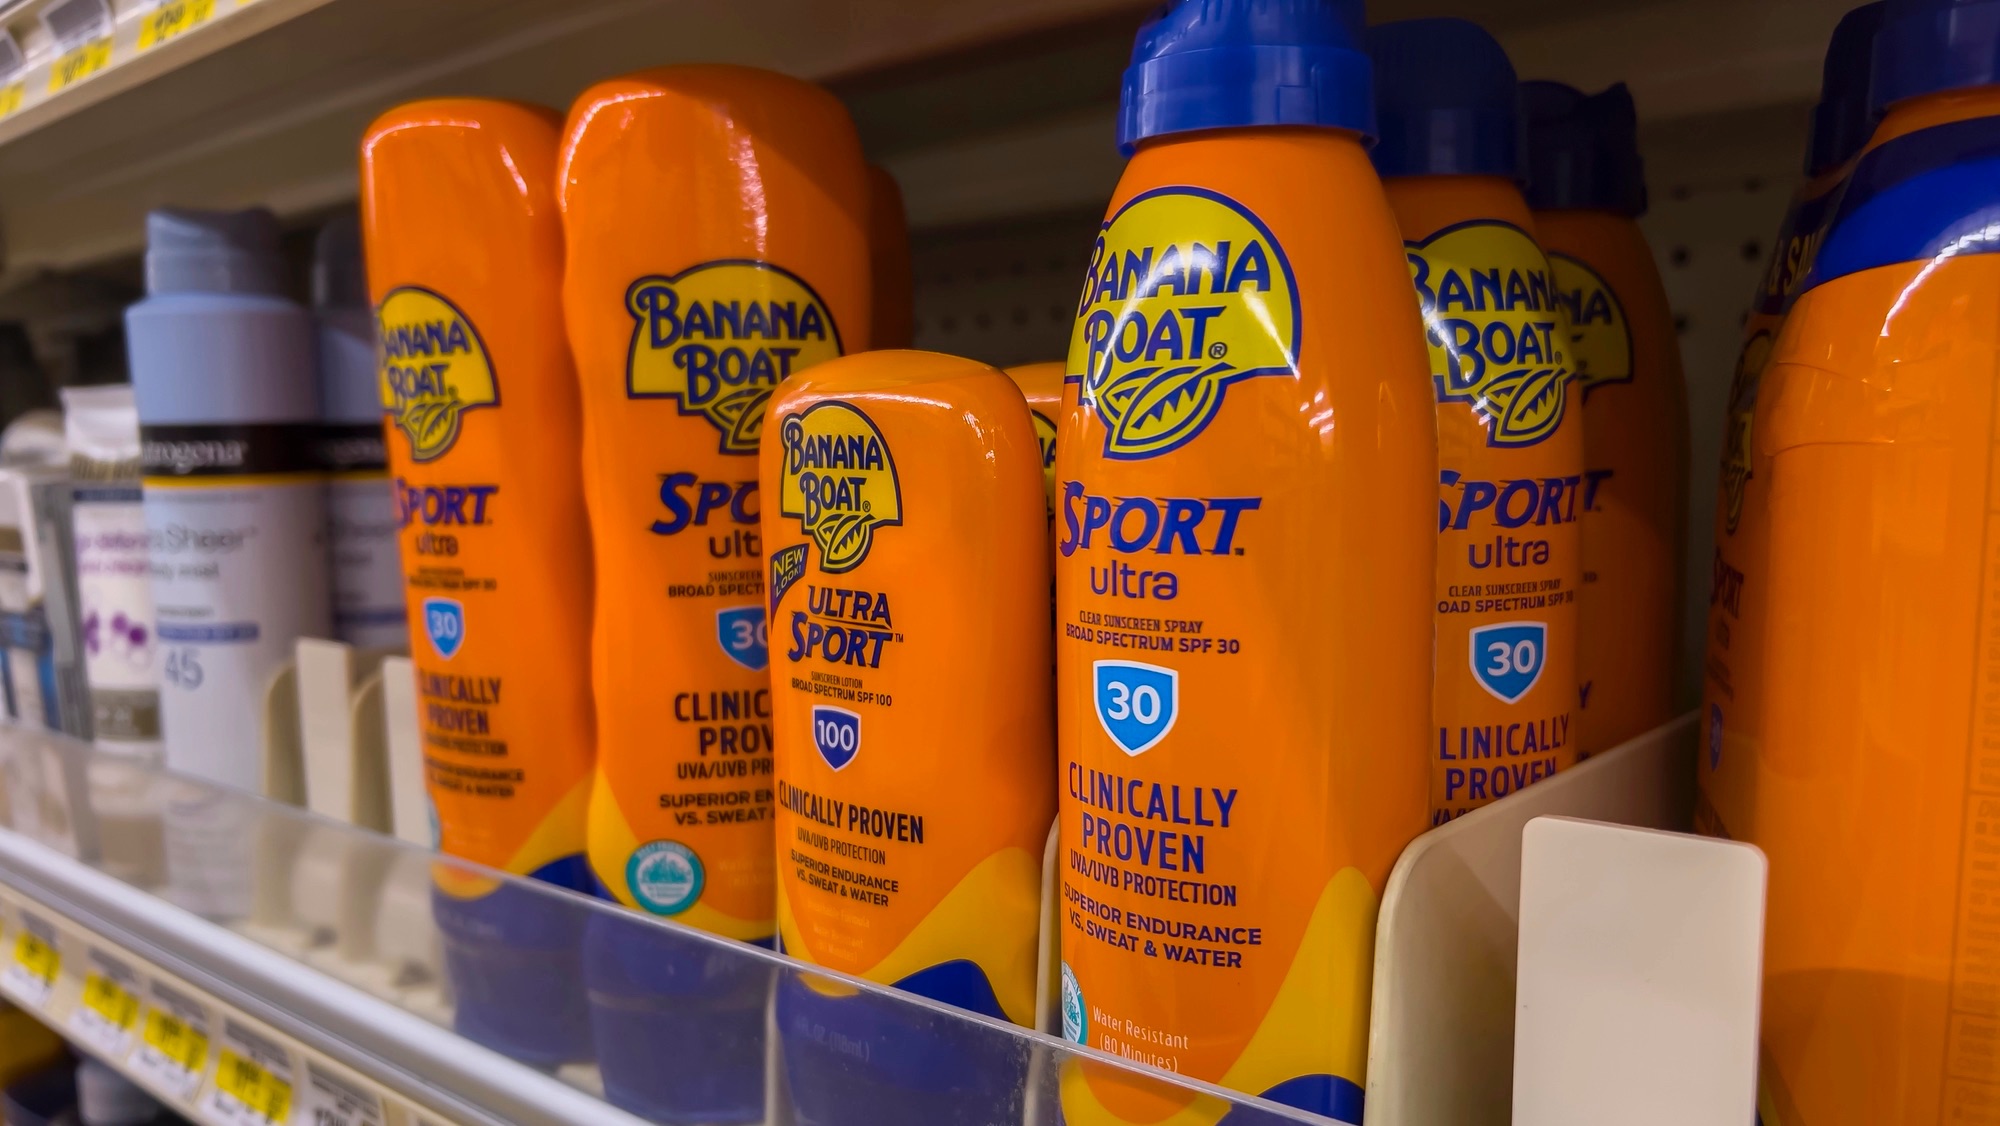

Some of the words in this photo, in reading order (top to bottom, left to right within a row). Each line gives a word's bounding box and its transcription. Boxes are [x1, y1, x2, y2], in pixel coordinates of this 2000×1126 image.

[1079, 239, 1271, 318] BANANA
[636, 285, 827, 350] BANANA
[380, 318, 472, 358] ANANA
[672, 344, 802, 404] BOAT
[785, 421, 884, 476] BANANA
[648, 472, 760, 536] SPO
[1059, 480, 1262, 557] SPORT
[708, 529, 762, 559] ult
[1468, 535, 1550, 570] ultra
[772, 547, 805, 584] NEW
[1090, 560, 1178, 600] ultra
[668, 584, 715, 598] BROAD
[718, 583, 765, 597] SPECT
[808, 585, 893, 630] ULTRA
[1437, 600, 1471, 614] OAD
[1474, 596, 1546, 613] SPECTRUM
[1547, 591, 1565, 607] SPF
[1448, 585, 1482, 598] CLEAR
[1485, 581, 1538, 596] SUNSCREEN
[1539, 578, 1562, 593] SPRAY
[430, 609, 457, 640] 30
[1066, 623, 1094, 643] BROAD
[1096, 630, 1173, 652] SPECTRUM
[1178, 638, 1212, 654] SPF
[1217, 639, 1240, 654] 30
[1079, 610, 1101, 626] CLEAR
[1104, 614, 1160, 632] SUNSCREEN
[1165, 620, 1203, 633] SPRAY
[164, 647, 205, 691] 45
[1487, 639, 1536, 677] 30
[791, 677, 813, 694] BROAD
[814, 682, 855, 701] SPECTRUM
[857, 691, 874, 704] SPF
[875, 692, 892, 707] 100
[811, 670, 841, 686] SUNSCREEN
[841, 676, 863, 689] LOTION
[674, 688, 773, 722] CLINIC
[1107, 680, 1161, 725] 30
[699, 723, 774, 757] PROV
[817, 719, 855, 751] 100
[1440, 712, 1569, 761] LINICALLY
[677, 760, 748, 780] UVA/UVB
[1446, 757, 1557, 801] PROVEN
[659, 790, 750, 809] SUPERIOR
[779, 779, 844, 830] CLINICALLY
[848, 803, 925, 845] PROVEN
[1069, 761, 1238, 828] CLINICALLY
[674, 811, 703, 827] VS.
[706, 807, 767, 825] SWEAT
[797, 826, 829, 852] UVA/UVB
[830, 834, 886, 866] PROTECTION
[1082, 811, 1204, 875] PROVEN
[790, 848, 830, 877] SUPERIOR
[831, 866, 899, 894] ENDURANCE
[808, 874, 840, 896] SWEAT
[840, 885, 848, 898] &
[849, 886, 889, 908] WATER
[1070, 848, 1119, 887] UVA/UVB
[1123, 870, 1237, 907] PROTECTION
[1064, 881, 1121, 925] SUPERIOR
[1126, 911, 1262, 945] ENDURANCE
[1069, 907, 1084, 932] VS.
[1086, 921, 1139, 952] SWEAT
[1144, 940, 1157, 957] &
[1163, 943, 1242, 968] WATER
[1093, 1004, 1122, 1032] Water
[1126, 1019, 1189, 1050] Resistant
[1100, 1034, 1118, 1054] (80
[1121, 1043, 1178, 1074] Minutes)
